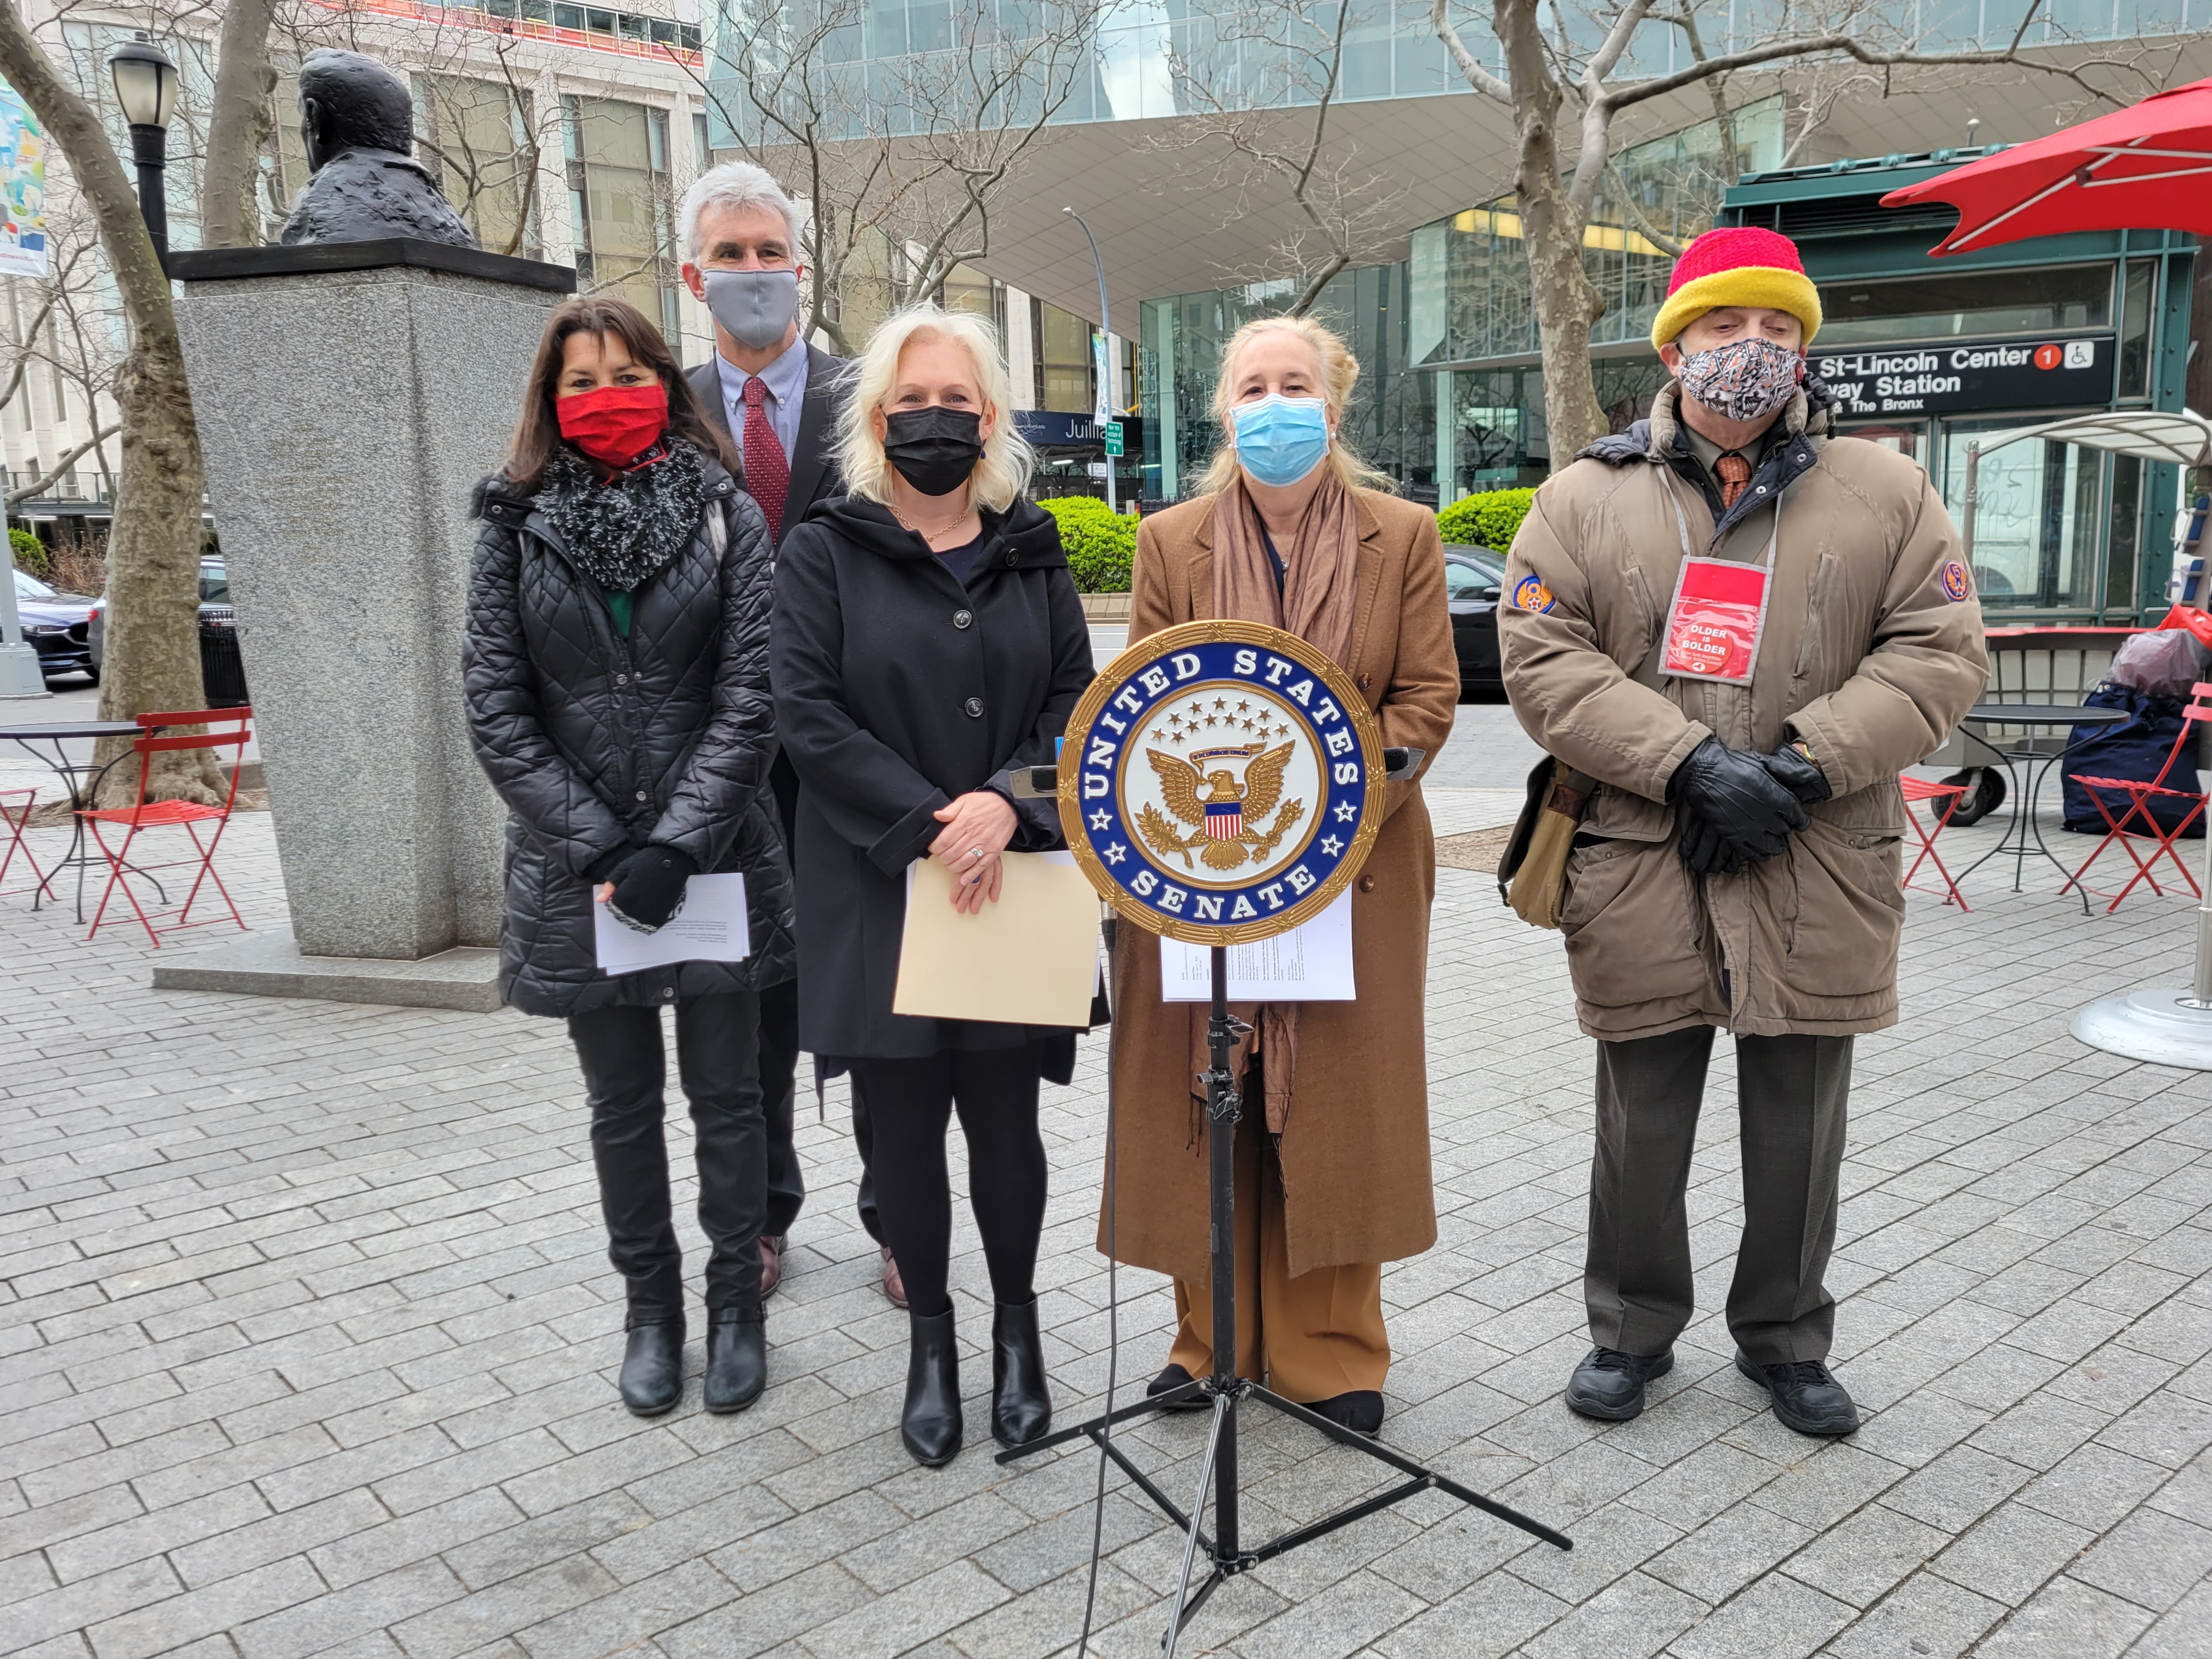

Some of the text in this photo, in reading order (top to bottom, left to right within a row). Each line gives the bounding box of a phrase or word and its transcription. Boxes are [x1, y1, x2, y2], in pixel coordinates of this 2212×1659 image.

[1819, 347, 2051, 379] St-Lincoln Center 1
[1875, 374, 1961, 396] Station
[1850, 400, 1877, 413] The
[1882, 398, 1923, 411] Bronx
[1691, 625, 1727, 639] OLDER
[1682, 640, 1726, 656] BOLDER
[1085, 650, 1358, 799] UNITED STATES
[1131, 864, 1317, 921] SENATE
